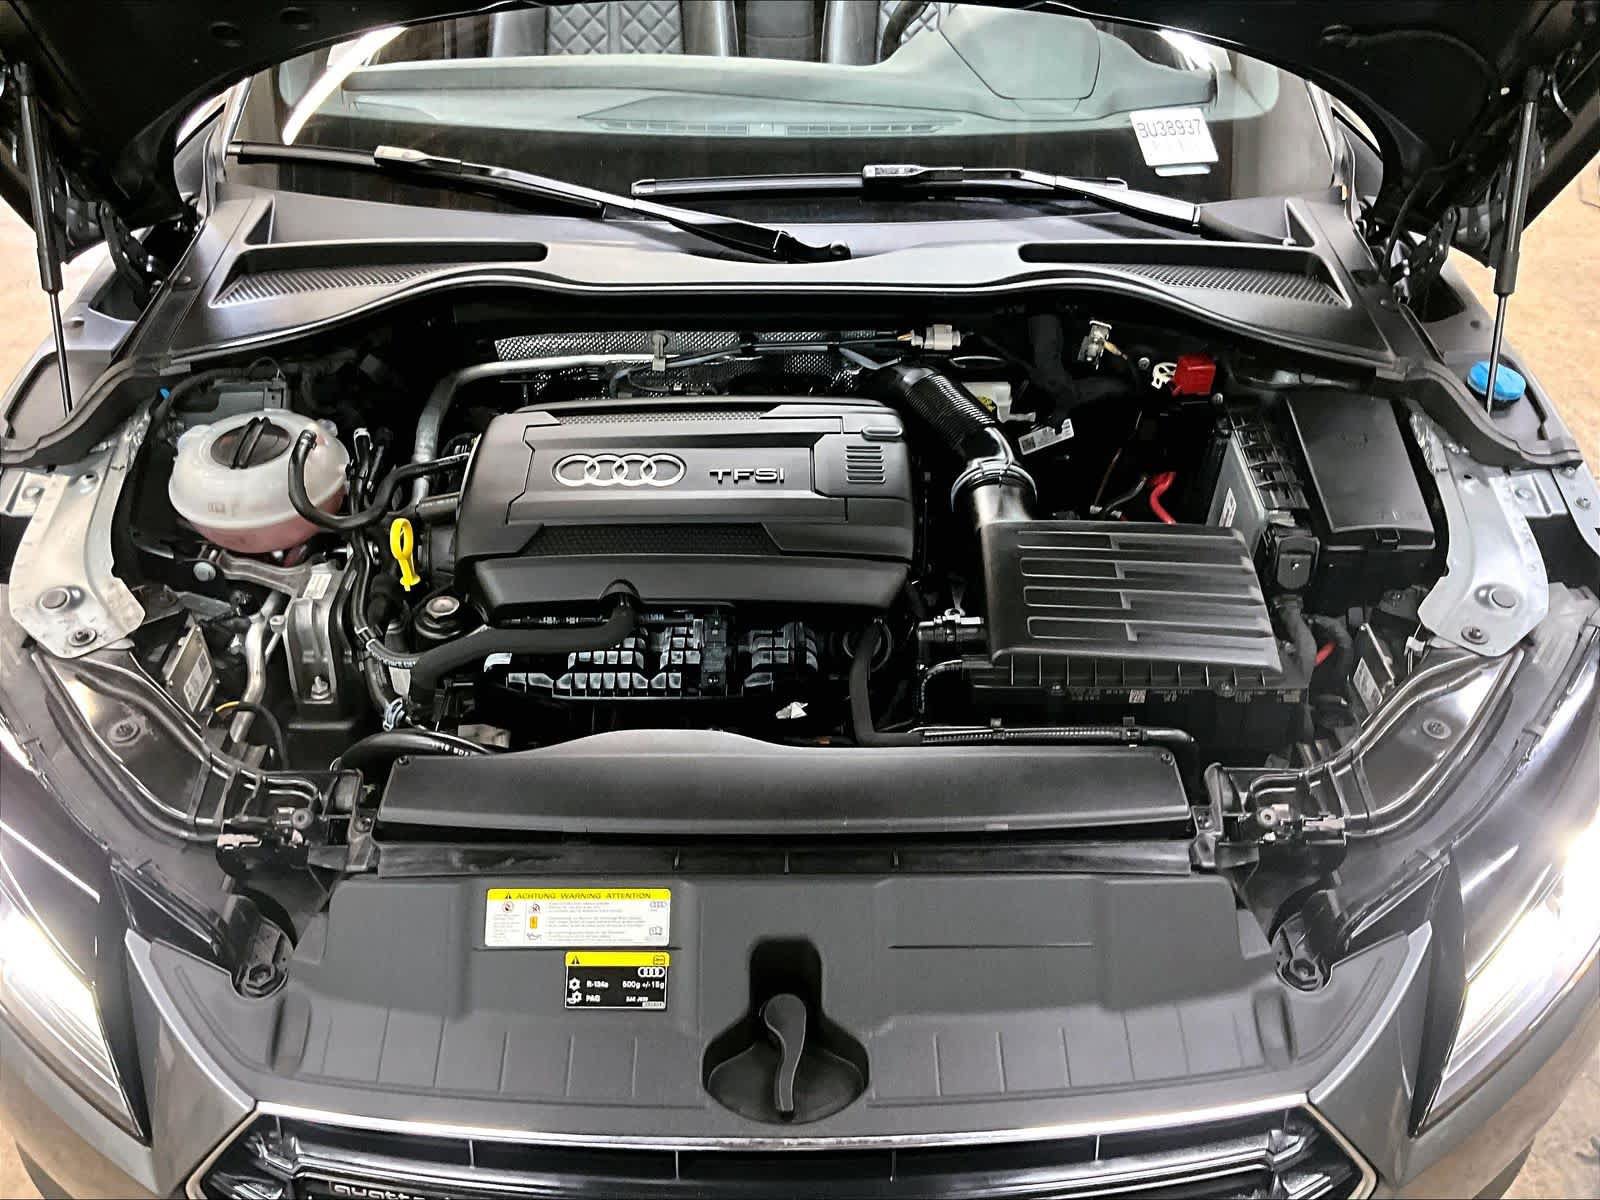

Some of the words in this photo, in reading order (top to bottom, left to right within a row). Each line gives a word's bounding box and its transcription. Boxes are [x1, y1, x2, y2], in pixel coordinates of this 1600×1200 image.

[709, 468, 785, 485] TFSI
[516, 892, 557, 900] ACHTUNG
[560, 892, 601, 900] WARNING
[605, 892, 651, 900] ATTENTION
